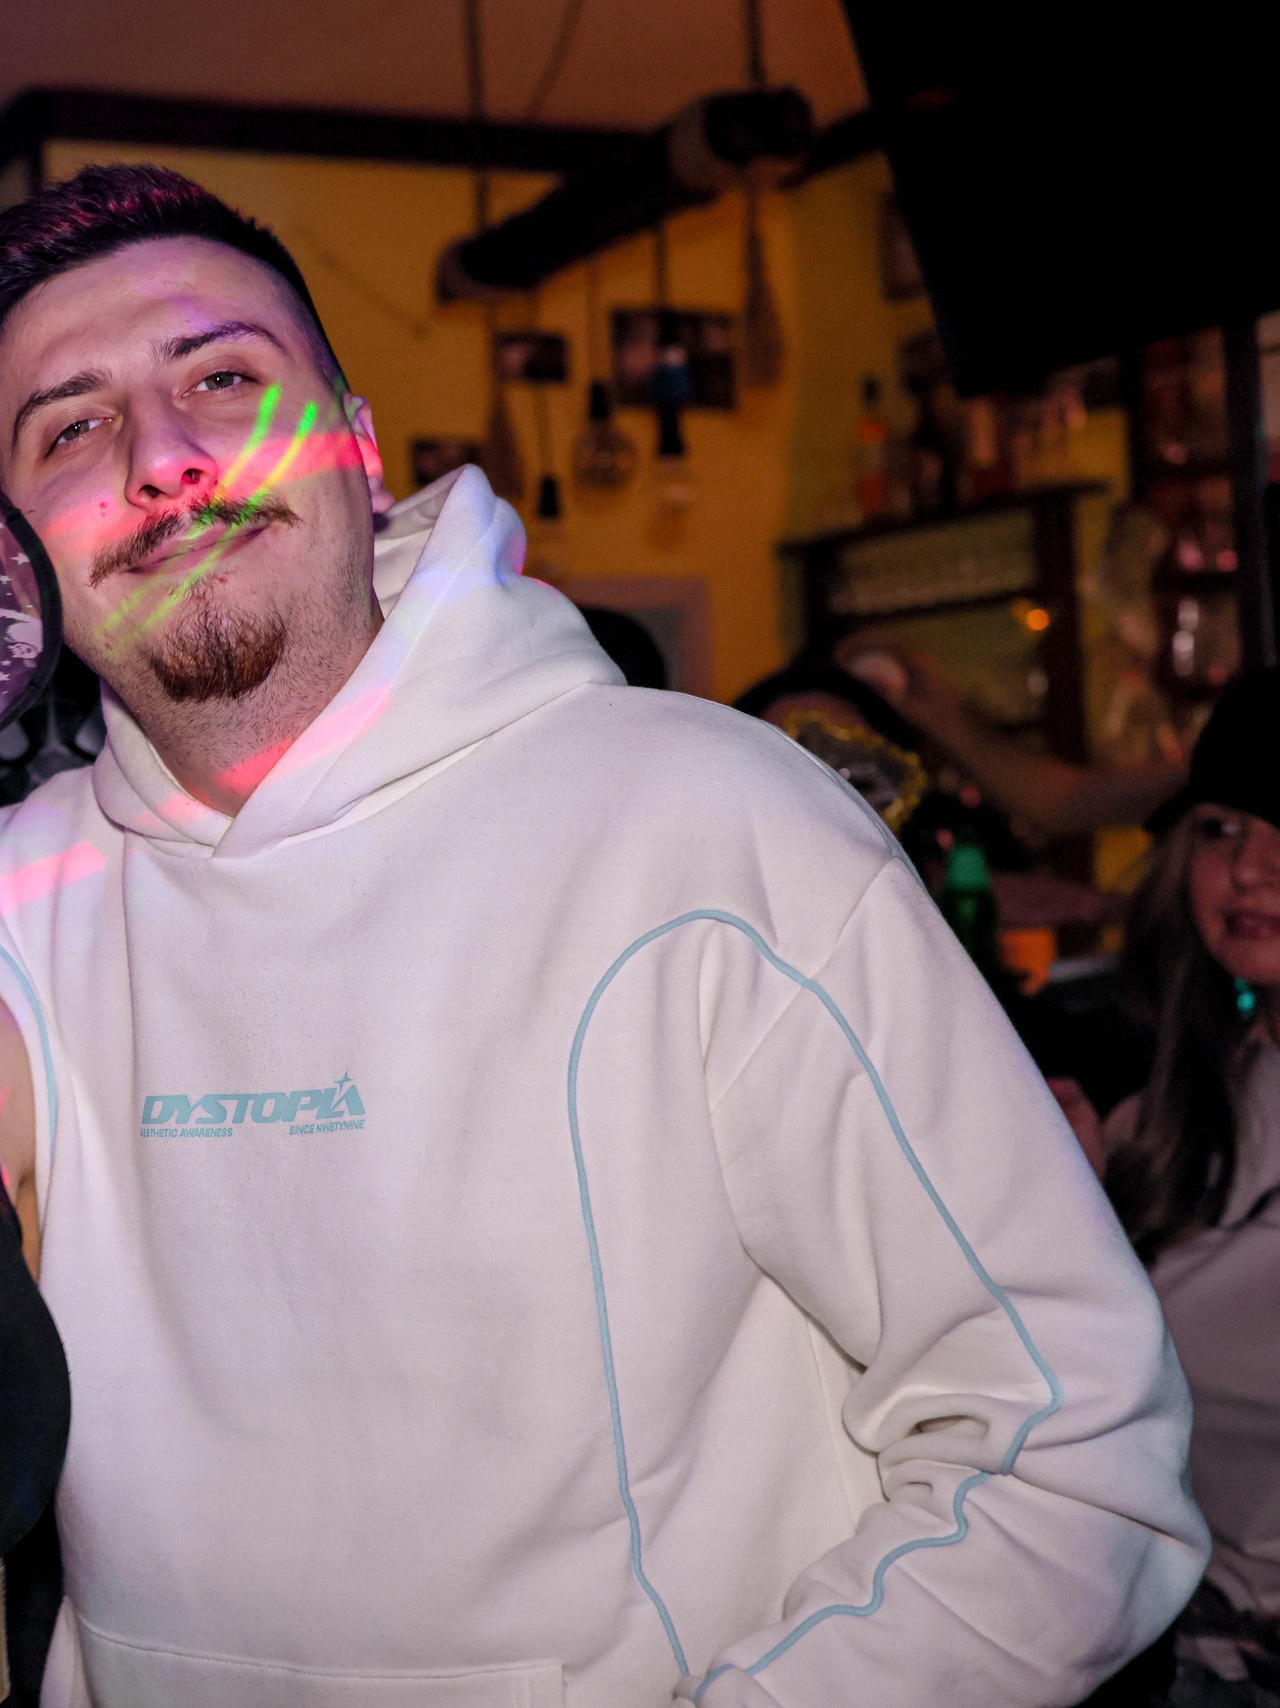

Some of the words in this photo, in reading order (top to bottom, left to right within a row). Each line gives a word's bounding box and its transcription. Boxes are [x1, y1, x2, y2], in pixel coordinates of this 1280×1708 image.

[141, 1084, 366, 1124] DYSTOPIA
[179, 1127, 233, 1138] AWARENESS
[289, 1124, 315, 1136] SINCE
[316, 1120, 365, 1134] NINETYNINE
